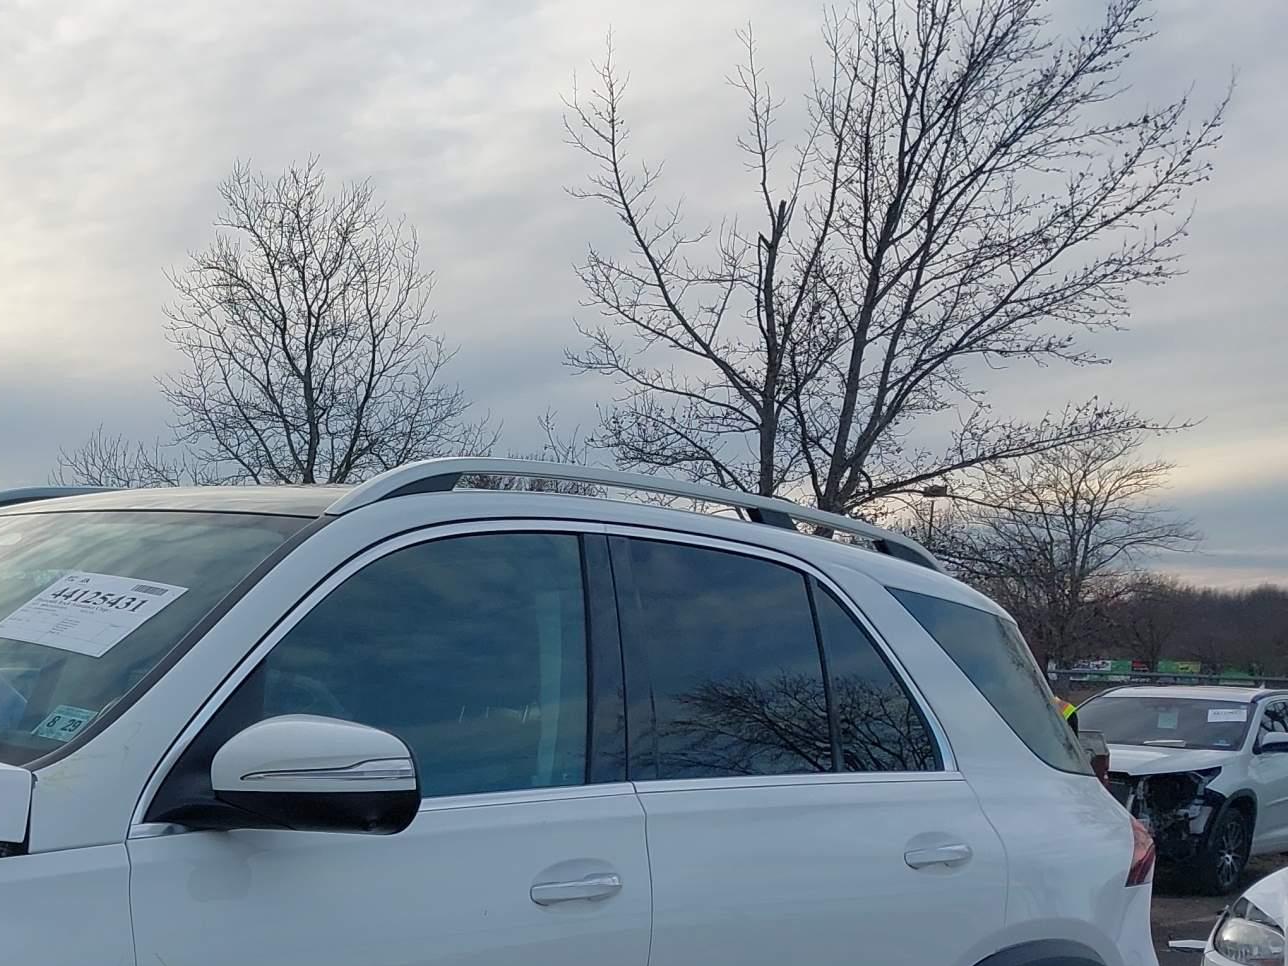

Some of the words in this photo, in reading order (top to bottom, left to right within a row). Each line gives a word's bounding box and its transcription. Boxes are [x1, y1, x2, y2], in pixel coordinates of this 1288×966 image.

[52, 587, 148, 612] 44125431
[47, 716, 61, 727] 8
[60, 719, 82, 732] 29
